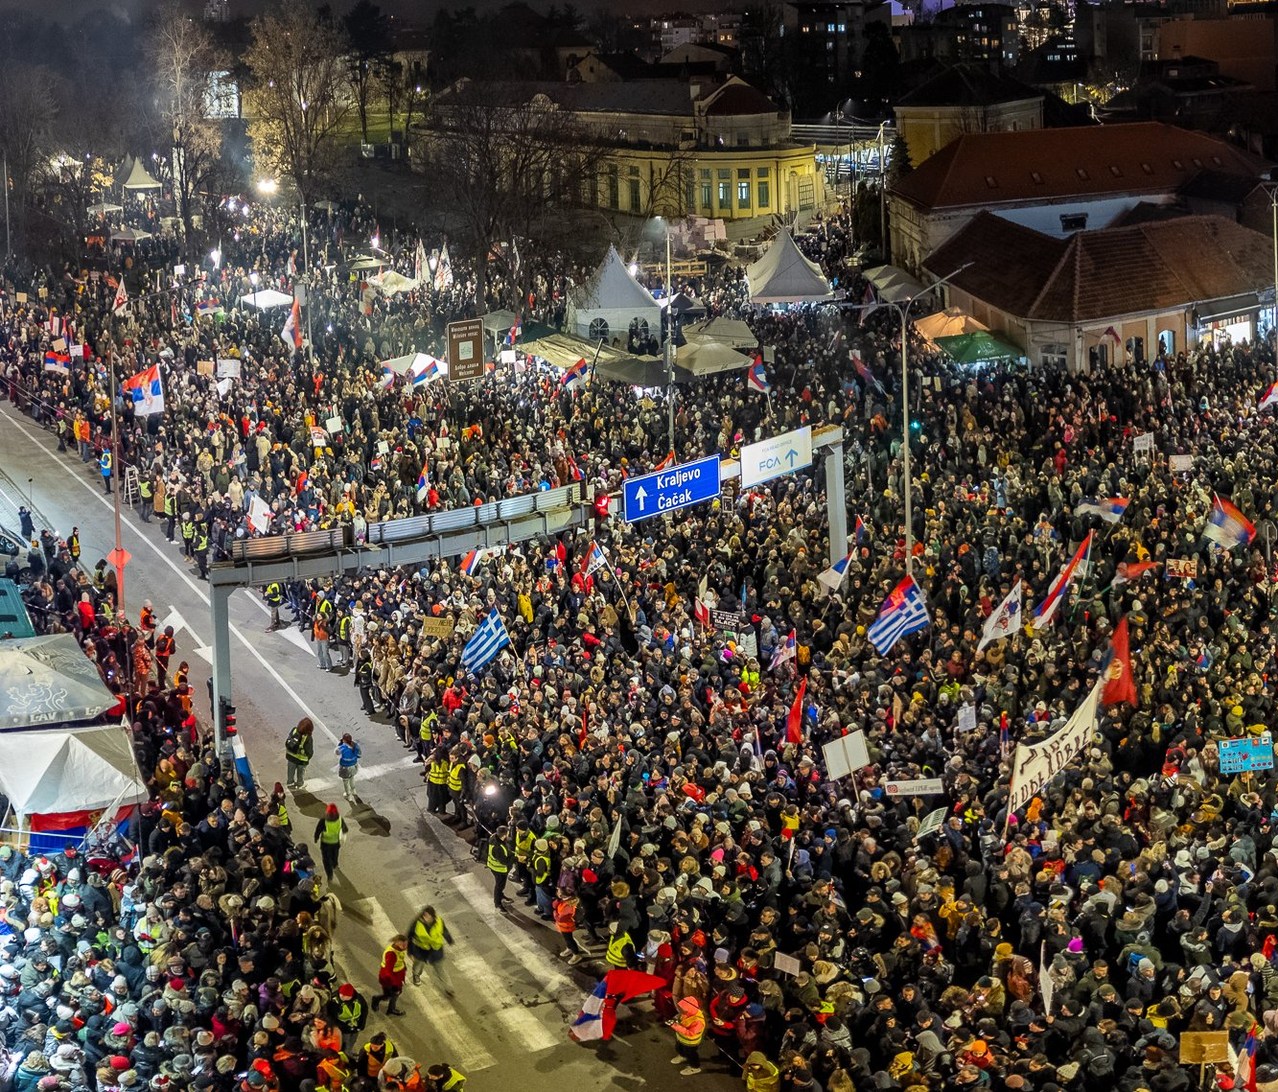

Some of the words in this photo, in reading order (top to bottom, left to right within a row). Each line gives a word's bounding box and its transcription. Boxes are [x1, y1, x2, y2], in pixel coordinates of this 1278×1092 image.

[759, 457, 781, 472] FCA
[656, 468, 701, 490] Kraljevo
[657, 489, 692, 510] Čačak
[29, 712, 58, 722] LAV
